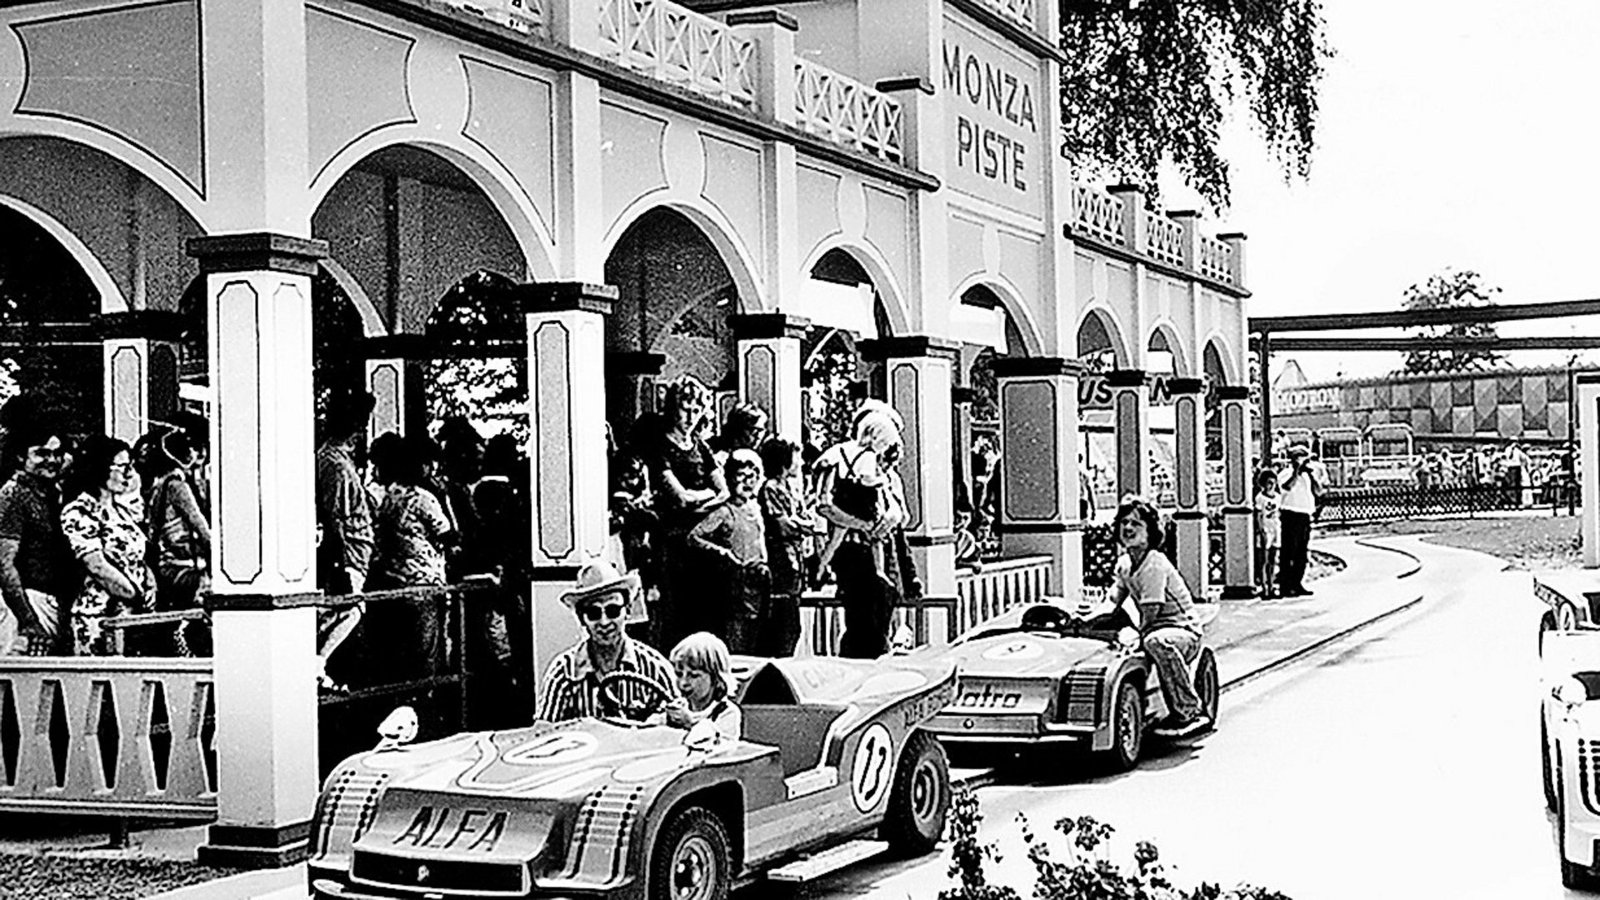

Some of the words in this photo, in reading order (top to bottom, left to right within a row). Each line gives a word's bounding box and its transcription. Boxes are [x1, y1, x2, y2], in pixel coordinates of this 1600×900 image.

[942, 39, 1036, 133] MONZA
[958, 116, 1026, 191] PISTE
[392, 806, 507, 851] ALFA
